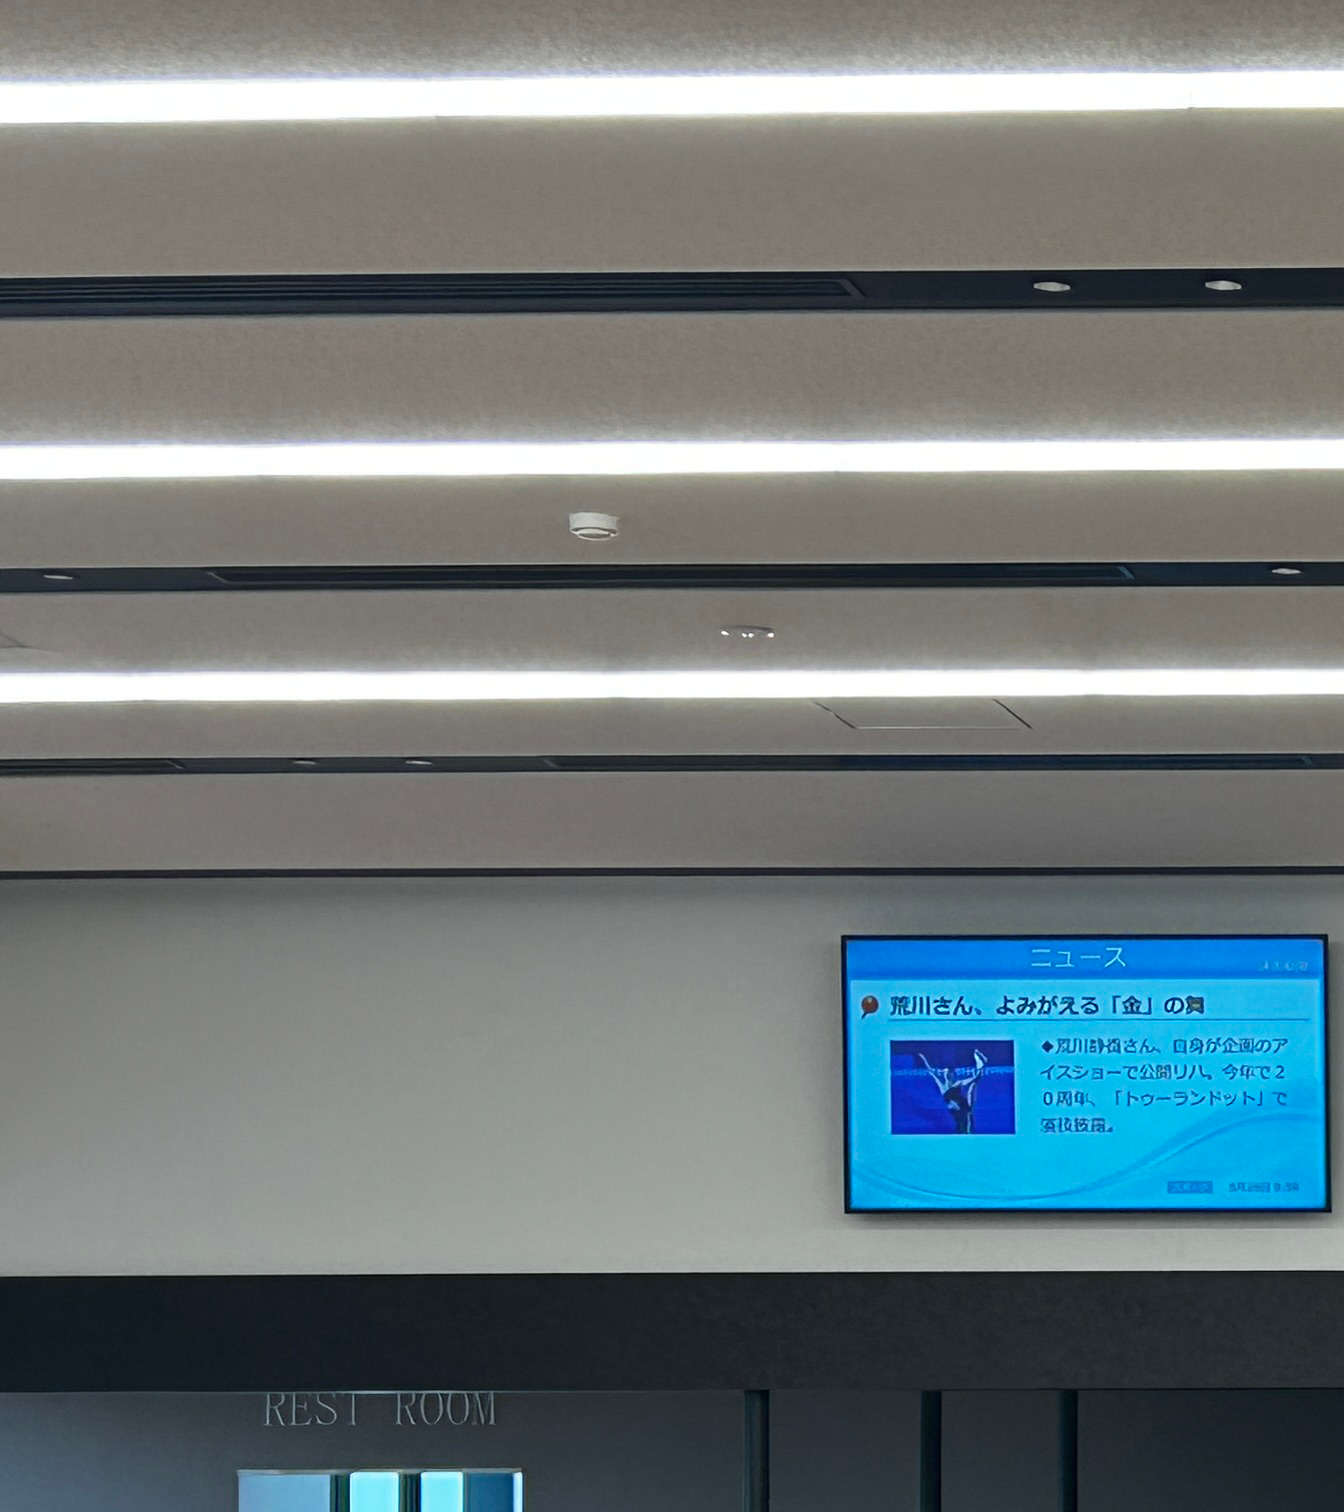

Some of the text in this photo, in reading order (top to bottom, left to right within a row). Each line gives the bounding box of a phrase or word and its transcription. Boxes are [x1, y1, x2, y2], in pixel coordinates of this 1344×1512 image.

[1031, 947, 1126, 968] ニュース
[263, 1391, 496, 1426] REST ROOM
